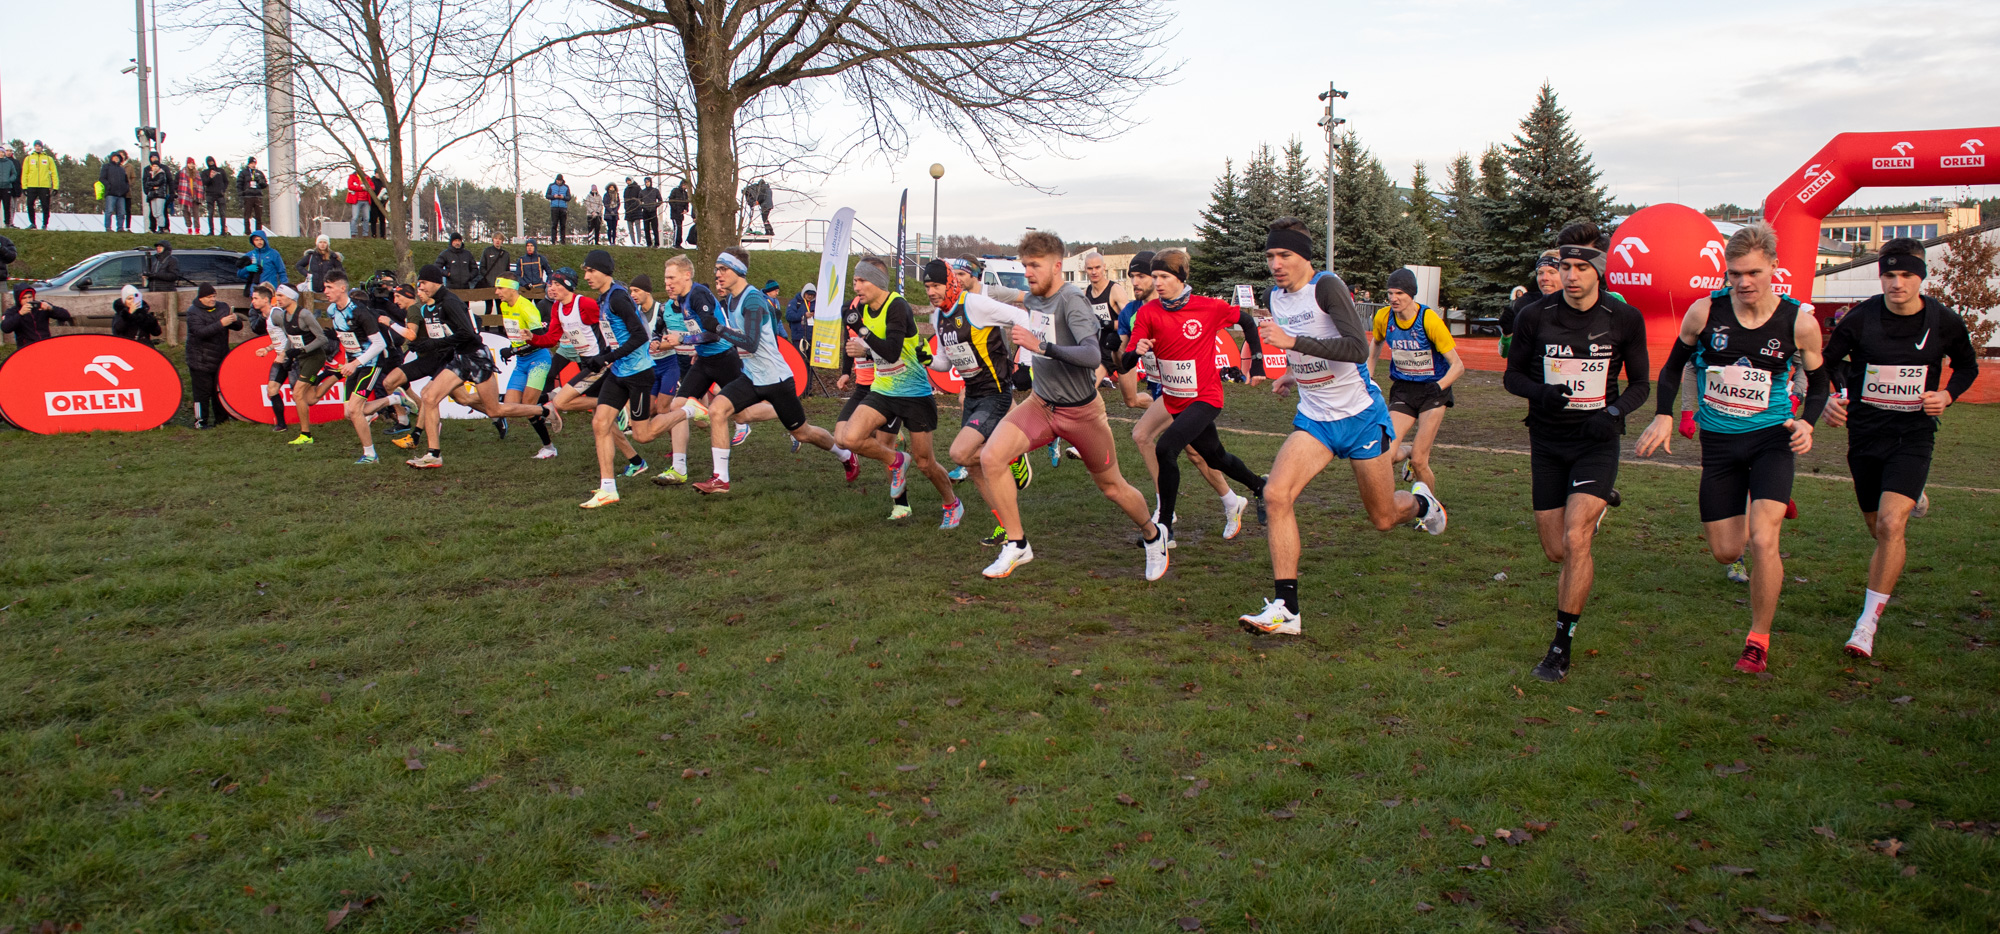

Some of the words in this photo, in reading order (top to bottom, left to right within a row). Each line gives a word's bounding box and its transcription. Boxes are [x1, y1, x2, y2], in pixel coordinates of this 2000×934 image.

[1874, 159, 1912, 168] ORLEN
[1943, 157, 1982, 166] ORLEN
[1801, 173, 1832, 200] ORLEN
[1609, 272, 1652, 286] ORLEN
[1392, 339, 1420, 350] ASTRA
[1760, 347, 1785, 359] CUBE
[1176, 362, 1191, 370] 169
[1581, 361, 1604, 372] 265
[1742, 370, 1766, 382] 338
[1899, 368, 1923, 378] 525
[1162, 374, 1193, 384] NOWAK
[1709, 380, 1766, 401] MARSZK
[1867, 382, 1922, 395] OCHNIK
[52, 392, 136, 412] ORLEN
